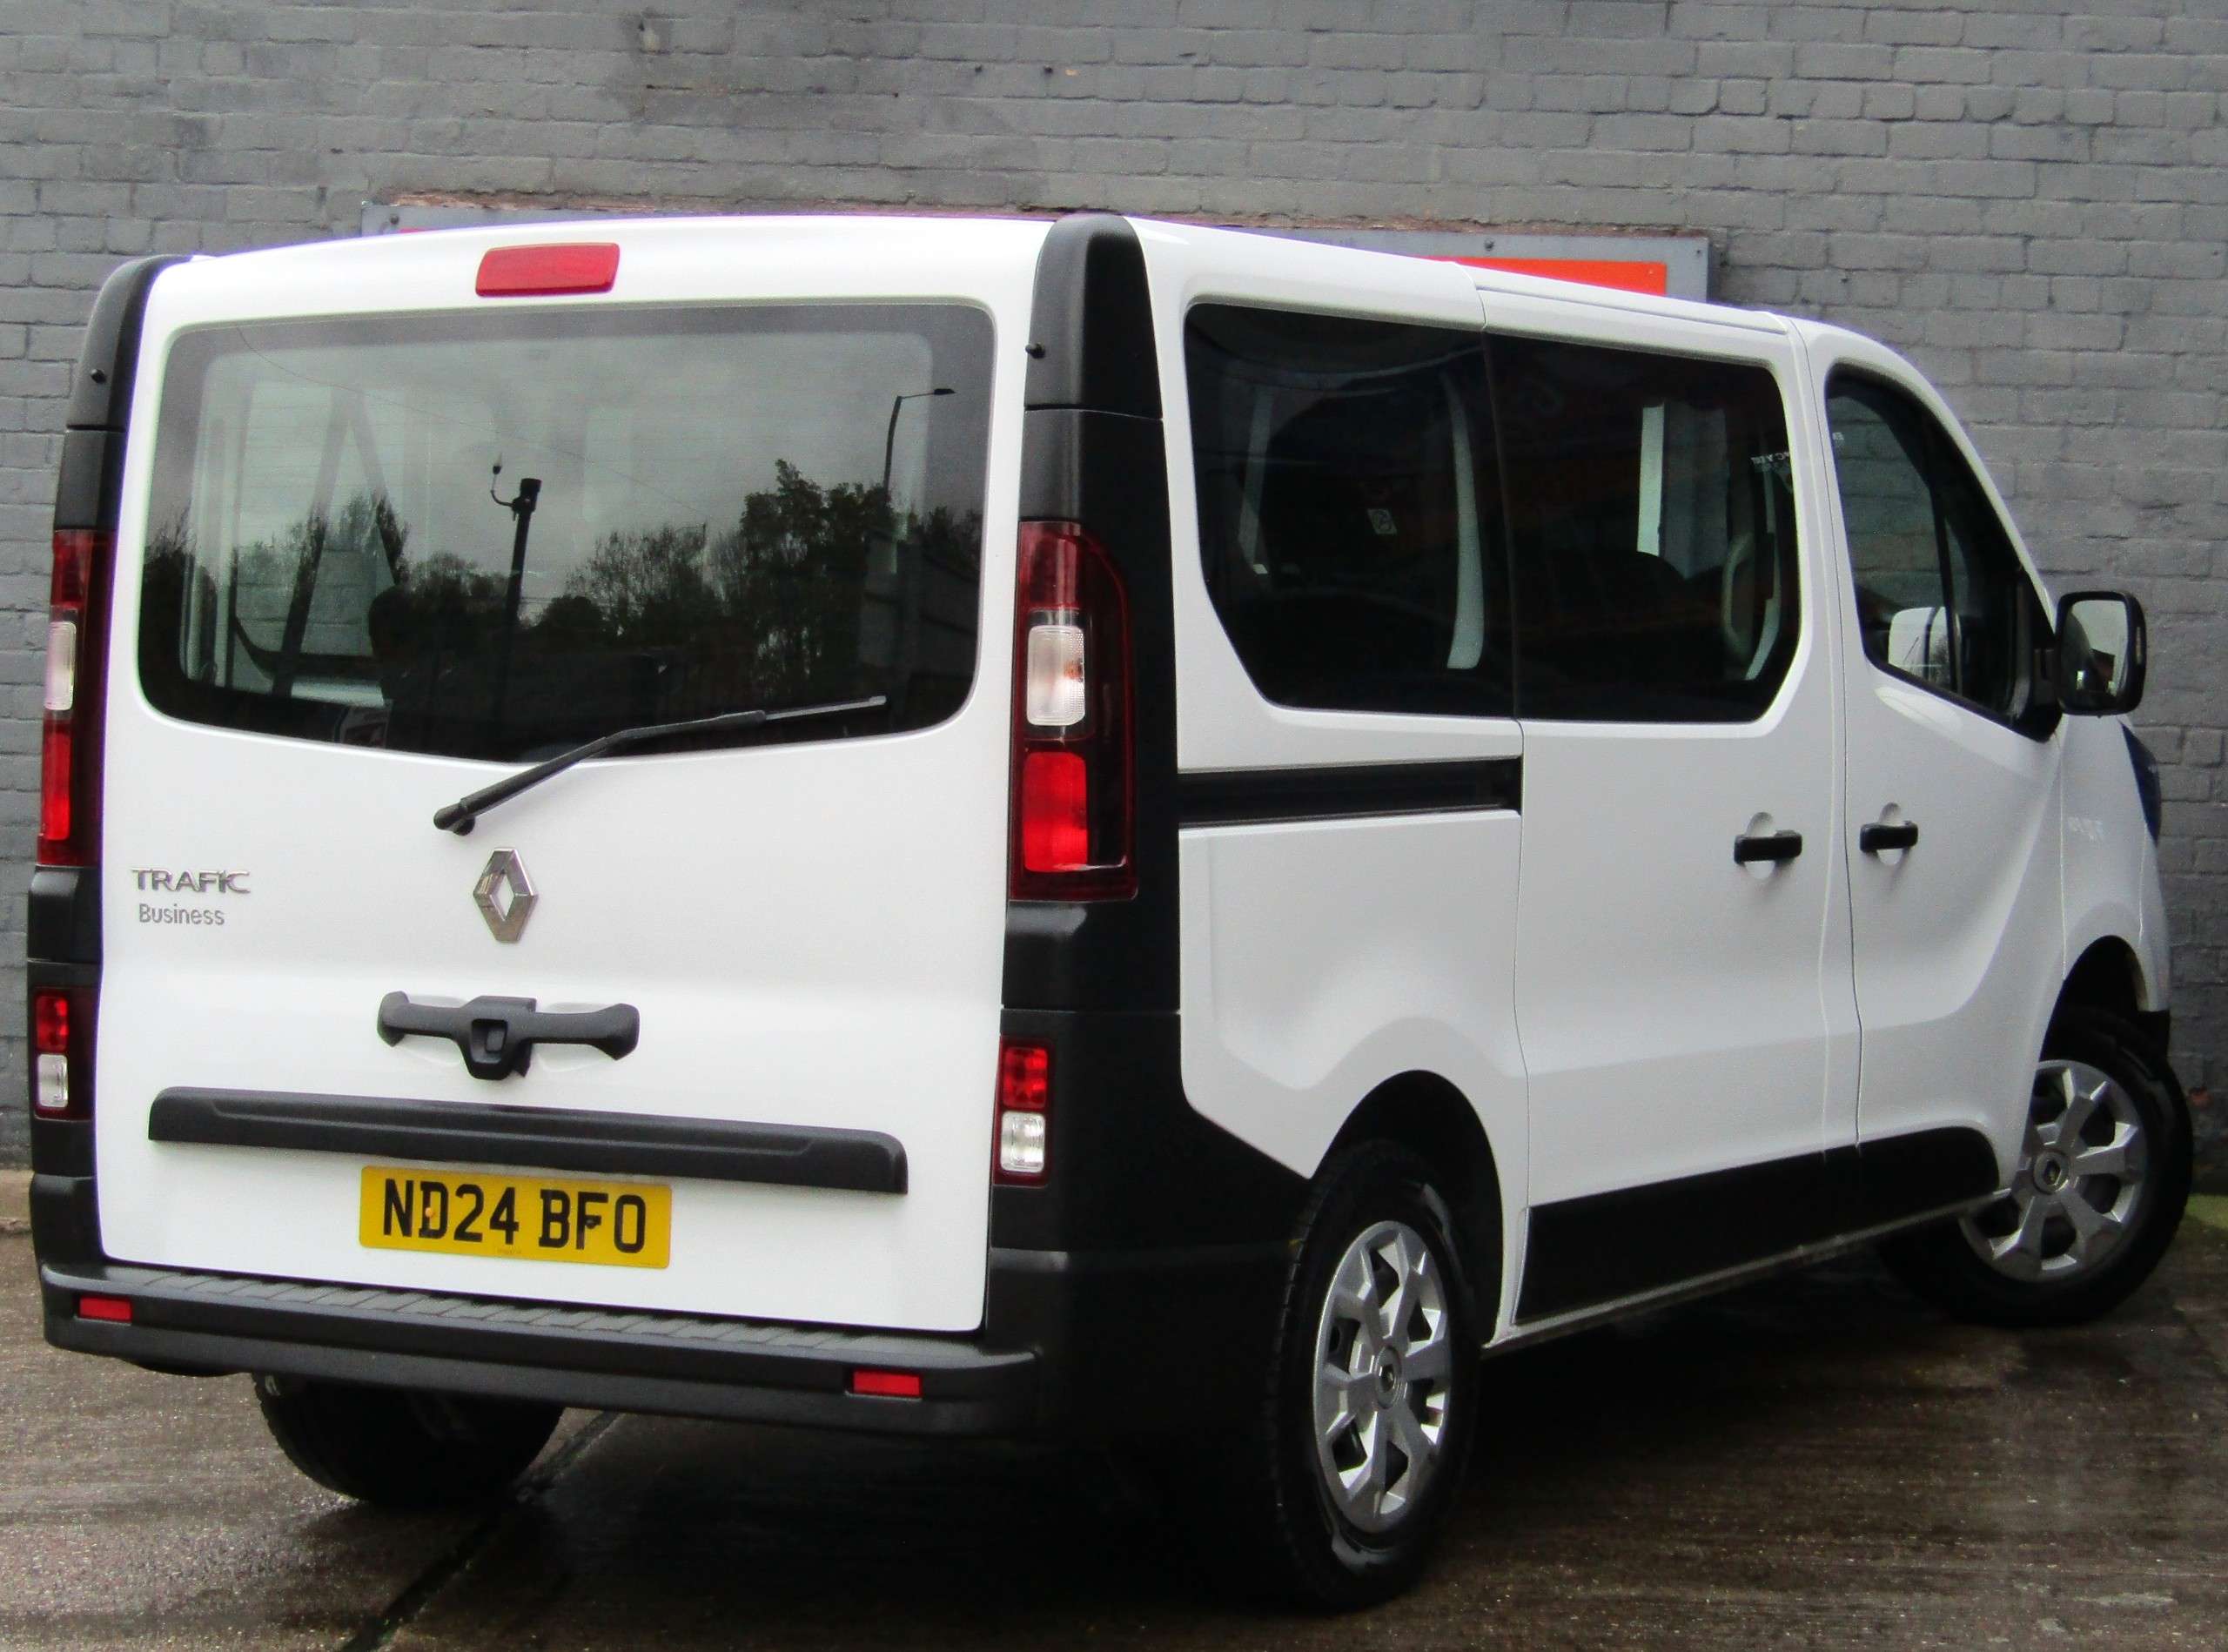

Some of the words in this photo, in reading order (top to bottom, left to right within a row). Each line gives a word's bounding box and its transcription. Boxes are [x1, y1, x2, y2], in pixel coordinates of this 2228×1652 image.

[131, 868, 251, 894] TRAFIC
[138, 903, 225, 925] Business
[383, 1178, 520, 1245] ND24
[538, 1188, 647, 1254] BFO
